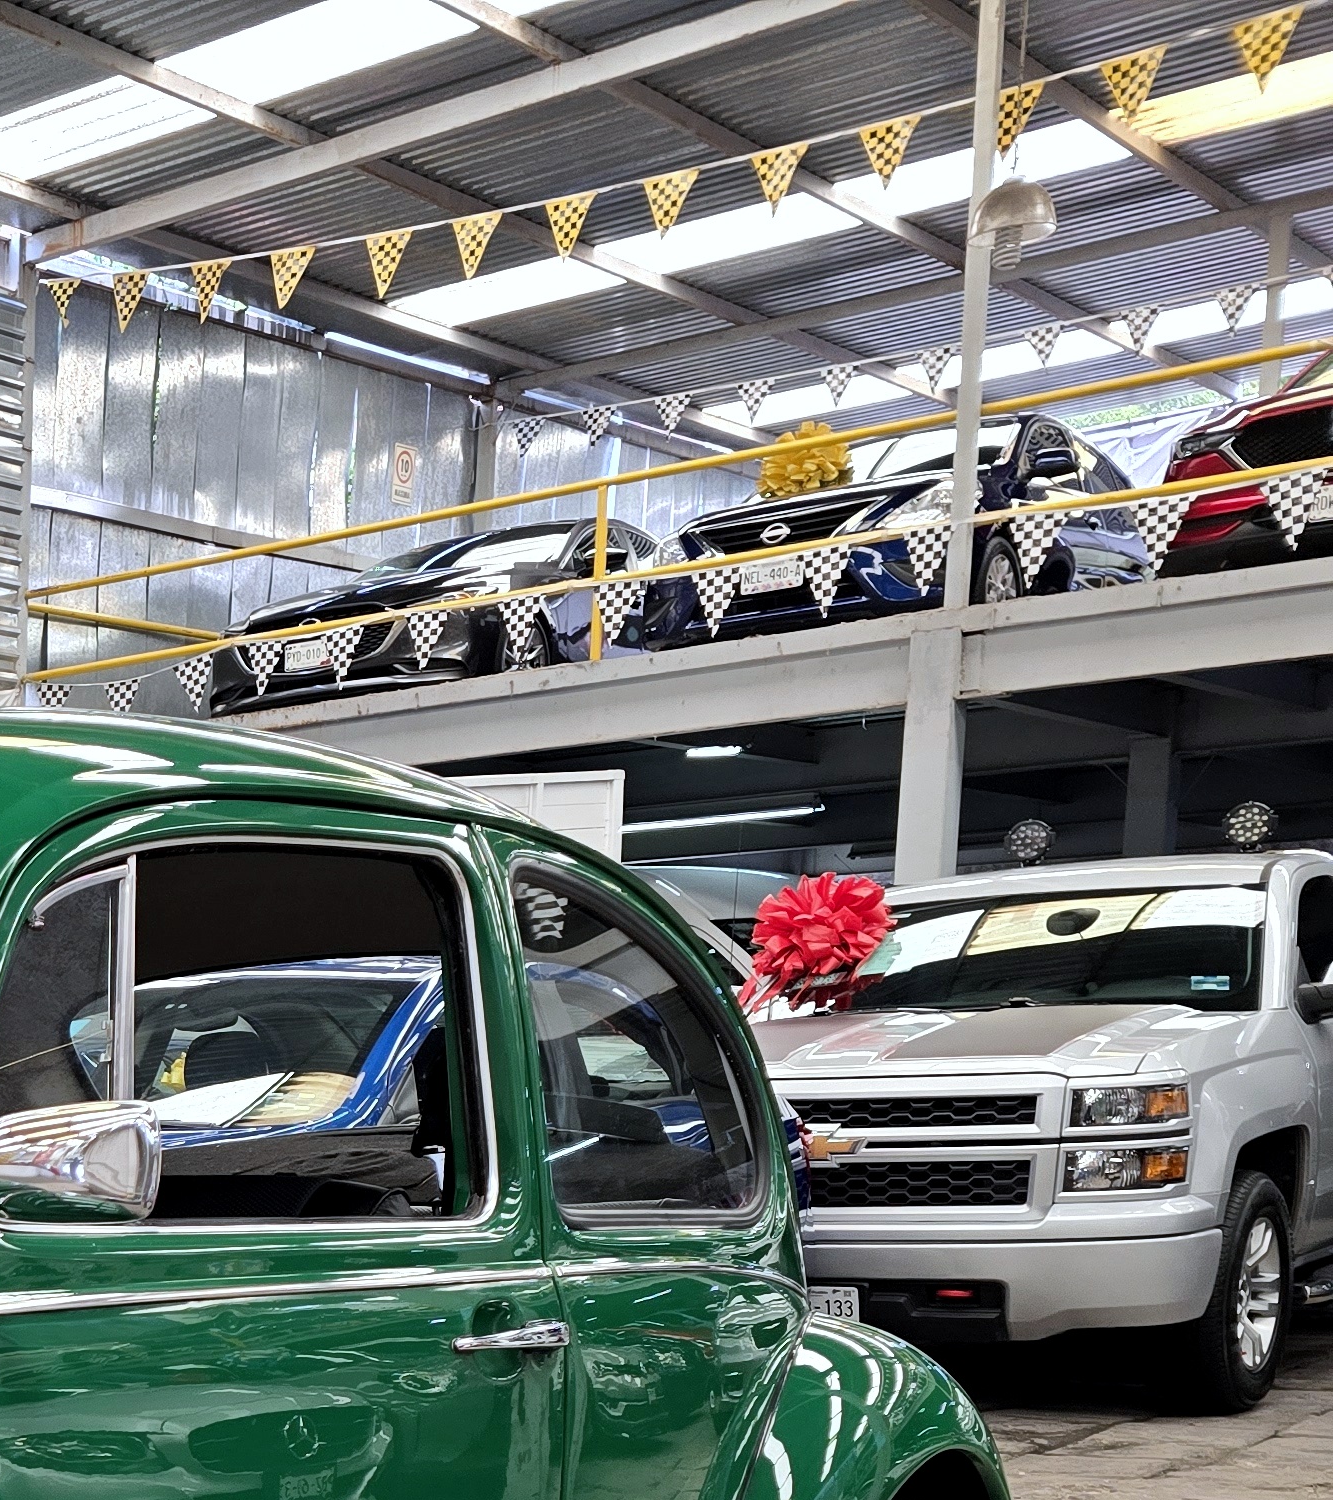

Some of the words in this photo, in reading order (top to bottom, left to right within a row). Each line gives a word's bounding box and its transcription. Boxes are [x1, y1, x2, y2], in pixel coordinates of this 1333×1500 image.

[400, 459, 410, 473] 10
[286, 647, 329, 663] PYD-010-
[808, 1299, 854, 1317] -133
